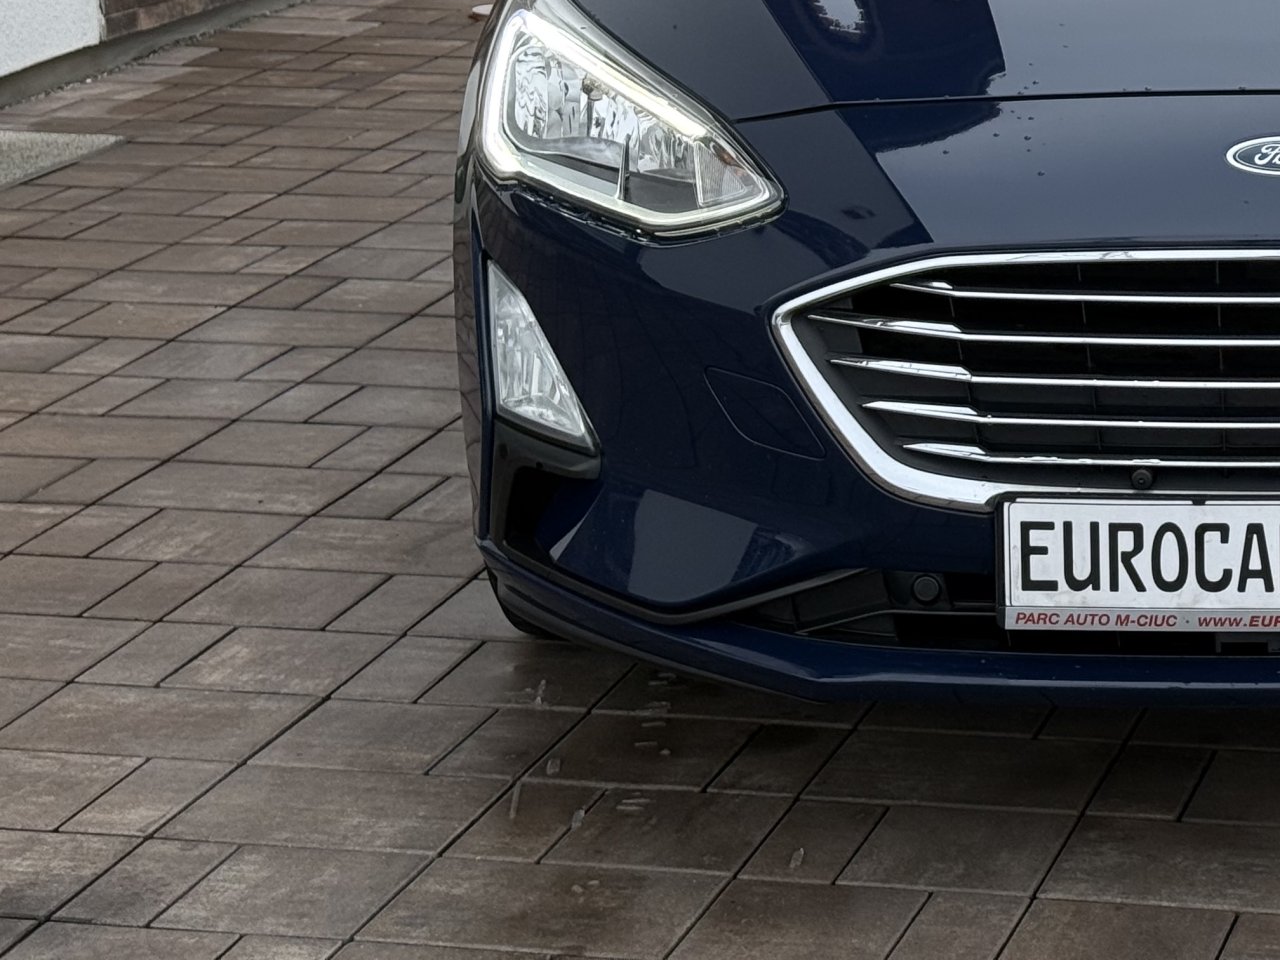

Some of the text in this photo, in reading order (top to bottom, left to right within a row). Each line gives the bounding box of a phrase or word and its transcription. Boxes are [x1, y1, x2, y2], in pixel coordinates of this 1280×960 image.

[1015, 612, 1061, 626] PARC
[1064, 613, 1111, 627] AUTO
[1115, 613, 1178, 628] M-CIUC
